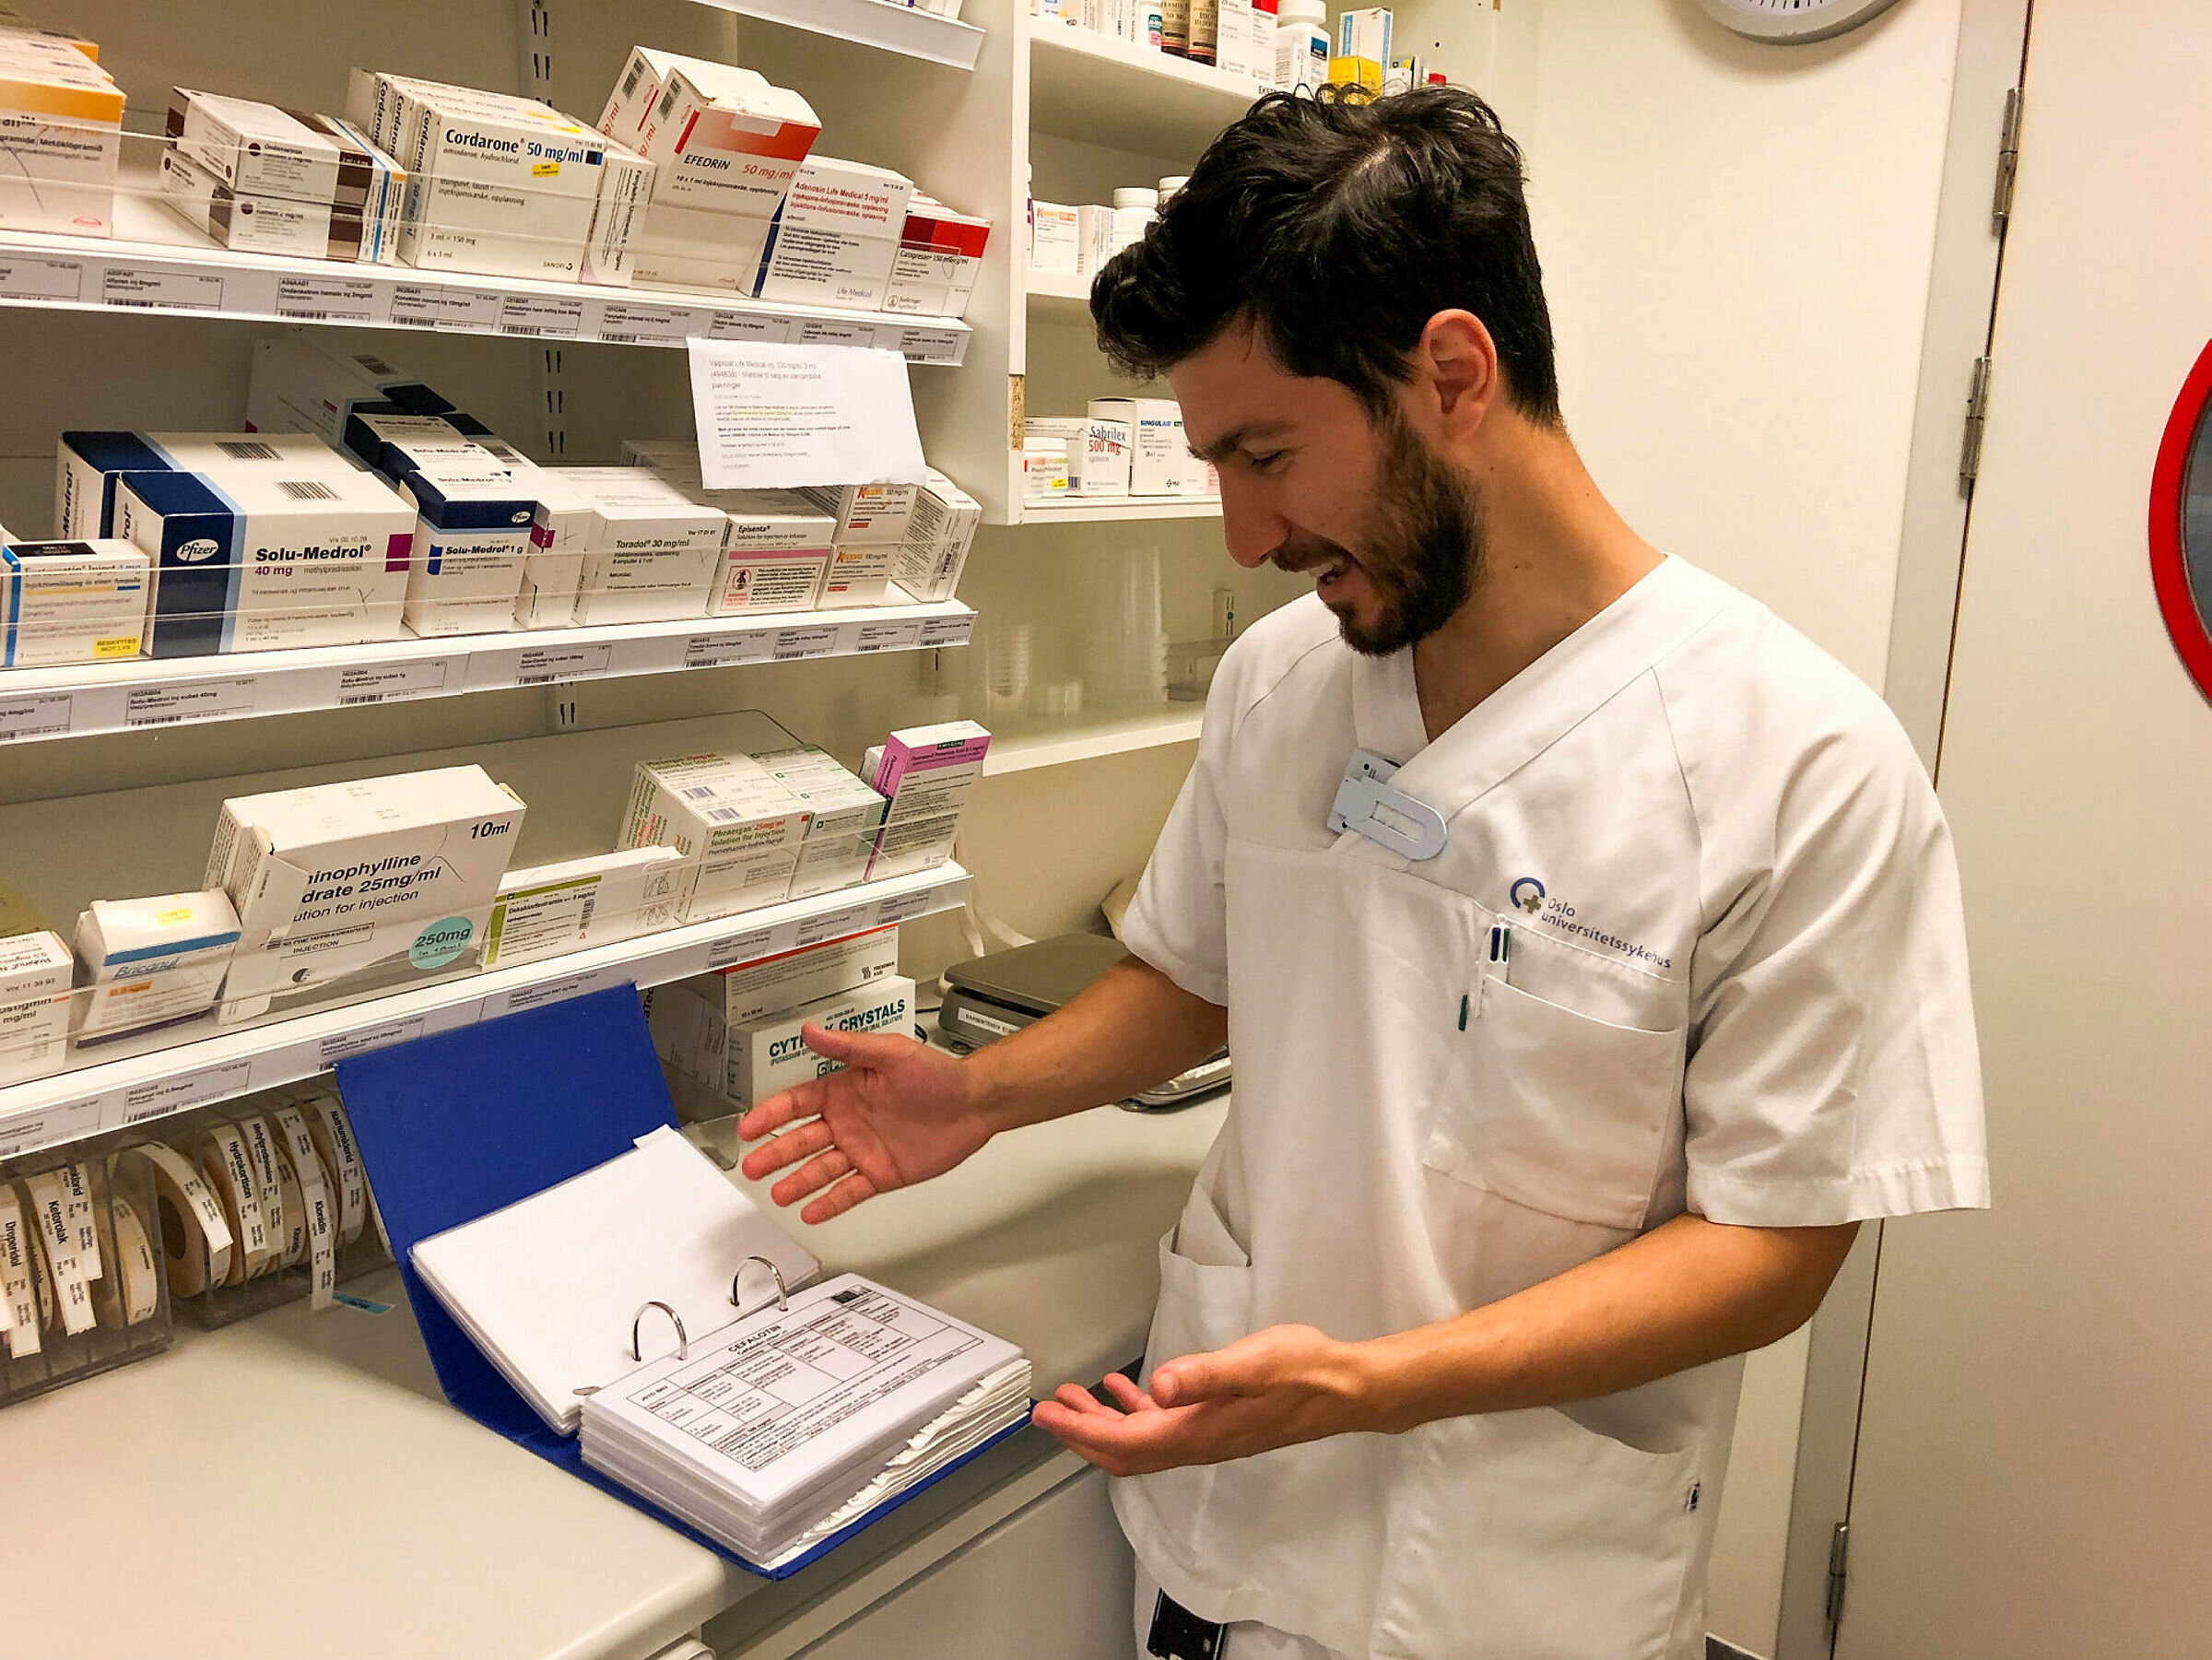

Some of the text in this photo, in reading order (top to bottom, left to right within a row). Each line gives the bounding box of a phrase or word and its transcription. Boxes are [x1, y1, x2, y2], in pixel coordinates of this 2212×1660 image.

[526, 141, 542, 157] 50
[545, 147, 584, 164] mg/ml
[683, 153, 731, 171] EFEDRIN
[741, 163, 757, 174] 50
[758, 166, 795, 181] mg/ml
[794, 182, 827, 194] Adenosin
[826, 185, 839, 196] Life
[840, 187, 865, 201] Medical
[1088, 425, 1126, 441] Sabrilex
[1088, 440, 1105, 453] 500
[180, 542, 218, 562] Pfizer
[652, 539, 663, 548] 30
[664, 538, 690, 548] mg/ml
[254, 565, 271, 576] 40
[273, 565, 293, 577] mg
[469, 820, 512, 841] 10ml
[300, 865, 442, 905] drate 25mg/ml
[292, 889, 420, 924] ution for injection
[1547, 897, 1576, 917] Oslo
[414, 927, 472, 949] 250mg
[3, 1010, 37, 1025] mg/ml
[838, 998, 906, 1032] CRYSTALS
[330, 1110, 355, 1163] Natriumklorid
[229, 1141, 253, 1198] Hydrokortison
[48, 1200, 69, 1244] Ketorolak
[315, 1200, 326, 1234] Klonidin
[5, 1220, 22, 1267] Droperidol
[728, 1324, 782, 1354] CEFALOTIN
